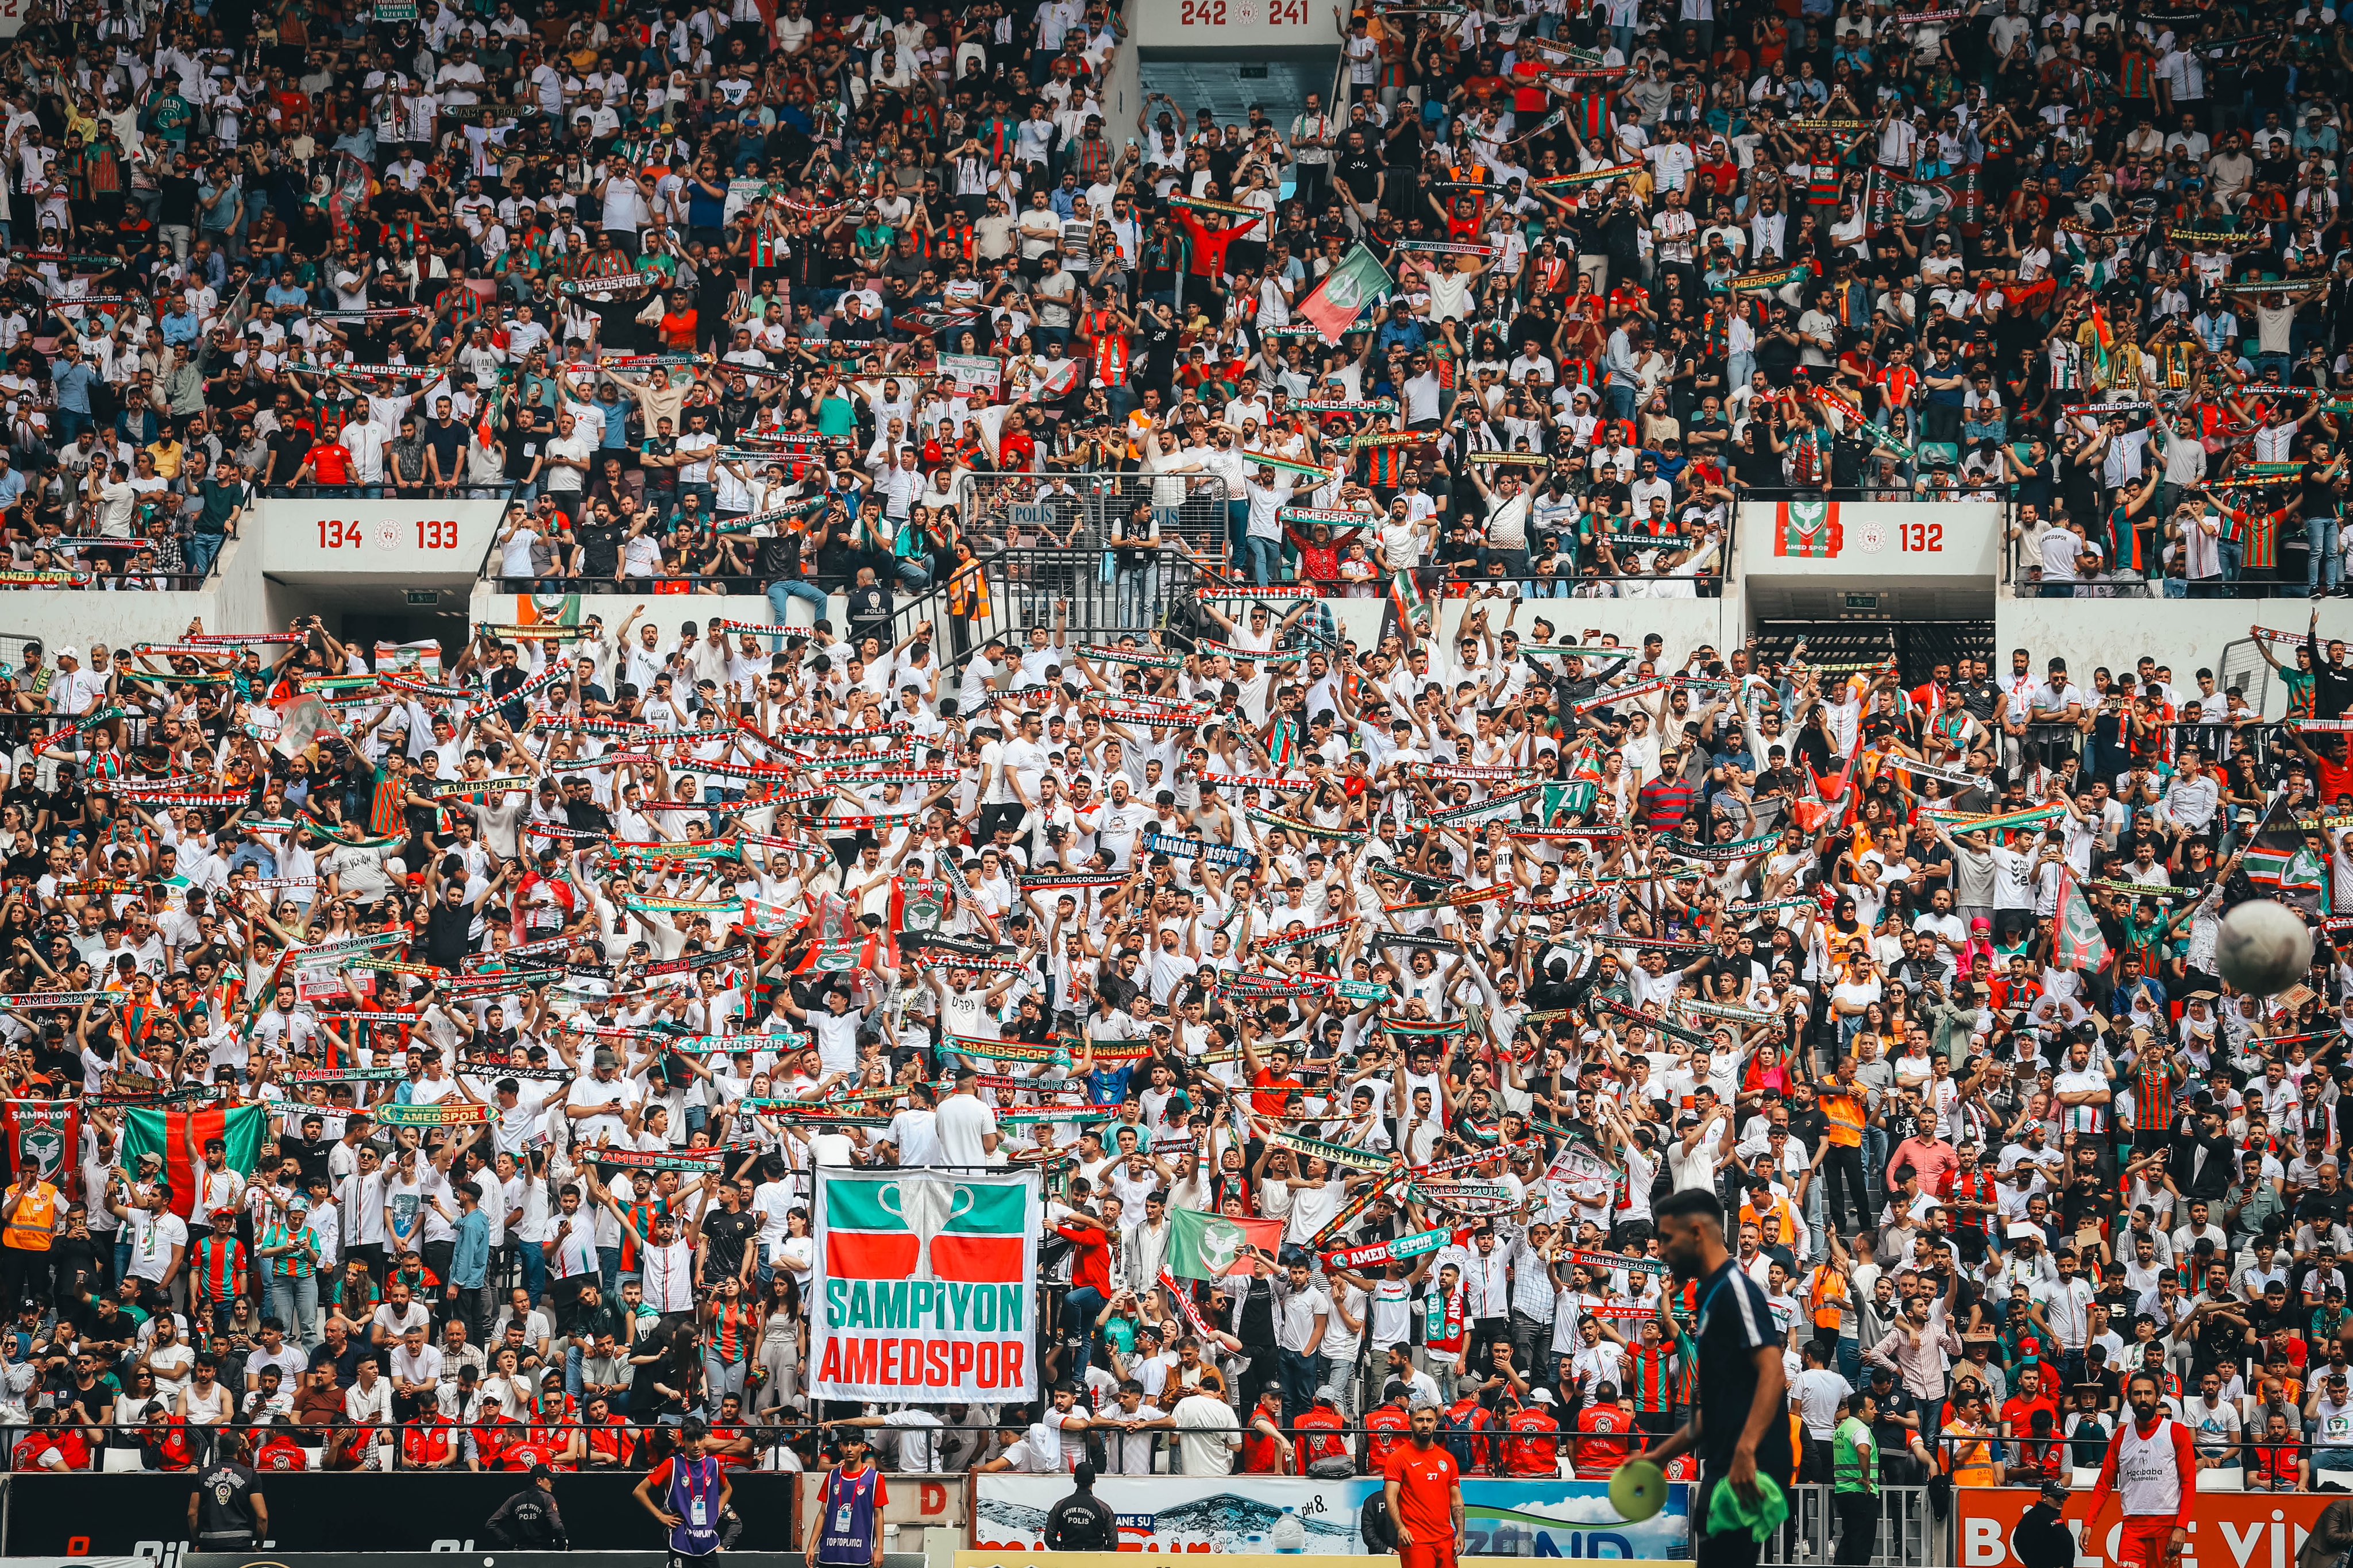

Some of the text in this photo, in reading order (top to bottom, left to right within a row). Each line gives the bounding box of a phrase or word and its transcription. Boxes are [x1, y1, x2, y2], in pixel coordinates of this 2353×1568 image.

[1182, 1, 1308, 25] 242 241
[1351, 161, 1368, 169] ITALY
[2171, 230, 2248, 240] AMEDSPOR
[1419, 242, 1480, 253] AMEDSPOR
[578, 279, 641, 292] AMEDSPOR
[353, 365, 422, 374] AMEDSPOR
[477, 358, 493, 367] GANT
[1301, 400, 1376, 410] AMEDSPOR
[2089, 400, 2152, 412] AMEDSPOR
[733, 503, 807, 528] AMEDSPOR
[1015, 505, 1052, 523] POLİS
[1297, 510, 1364, 525] AMEDSPOR
[318, 520, 458, 549] 134 133
[1614, 535, 1681, 545] AMEDSPOR
[1899, 524, 1943, 551] 132
[2042, 534, 2067, 543] AMEDSPOR
[1785, 543, 1829, 551] AMED SPOR
[0, 572, 72, 581] AMED SPOR
[1094, 650, 1164, 666] AMEDSPOR
[1214, 645, 1293, 659] AMEDSPOR
[393, 679, 459, 697] AMEDSPOR
[2300, 720, 2340, 731] ŞAMPİYON
[1432, 768, 1513, 780] AMEDSPOR
[109, 778, 190, 791] AMEDSPOR
[449, 782, 512, 793] AMEDSPOR
[1557, 785, 1583, 808] 21
[539, 826, 608, 839] AMEDSPOR
[1537, 827, 1608, 836] KARAÇOCUKLAR
[348, 856, 371, 870] VENOM
[240, 876, 317, 891] AMEDSPOR
[645, 899, 722, 909] AMEDSPOR
[1726, 895, 1807, 912] AMEDSPOR
[300, 936, 381, 954] AMEDSPOR
[816, 939, 870, 951] ŞAMPİYON
[931, 935, 986, 951] AMEDSPOR
[1389, 936, 1451, 947] AMEDSPOR
[647, 951, 731, 975] AMEDSPOR
[453, 970, 549, 986] AMEDSPOR
[341, 1011, 417, 1021] AMEDSPOR
[1610, 1002, 1702, 1044] AMEDSPOR
[699, 1040, 784, 1052] AMEDSPOR
[962, 1045, 1048, 1061] AMEDSPOR
[296, 1068, 393, 1080] AMEDSPOR
[11, 1110, 72, 1122] ŞAMPİYON
[402, 1111, 480, 1122] AMEDSPOR
[1291, 1140, 1372, 1164] AMEDSPOR
[600, 1152, 703, 1169] AMEDSPOR
[1427, 1144, 1517, 1175] AMEDSPOR
[1421, 1184, 1500, 1197] AMEDSPOR
[1351, 1235, 1432, 1264] AMED SPOR
[1580, 1256, 1654, 1272] AMEDSPOR
[826, 1279, 1022, 1332] ŞAMPİYON
[818, 1337, 1023, 1389] AMEDSPOR
[205, 1472, 246, 1488] SPOR ŞUBE
[920, 1482, 947, 1515] D
[1302, 1494, 1328, 1519] pH 8.
[1077, 1507, 1096, 1521] KUVVET
[1116, 1516, 1151, 1527] ANE SU
[827, 1537, 862, 1548] TOP TOPLAYICI
